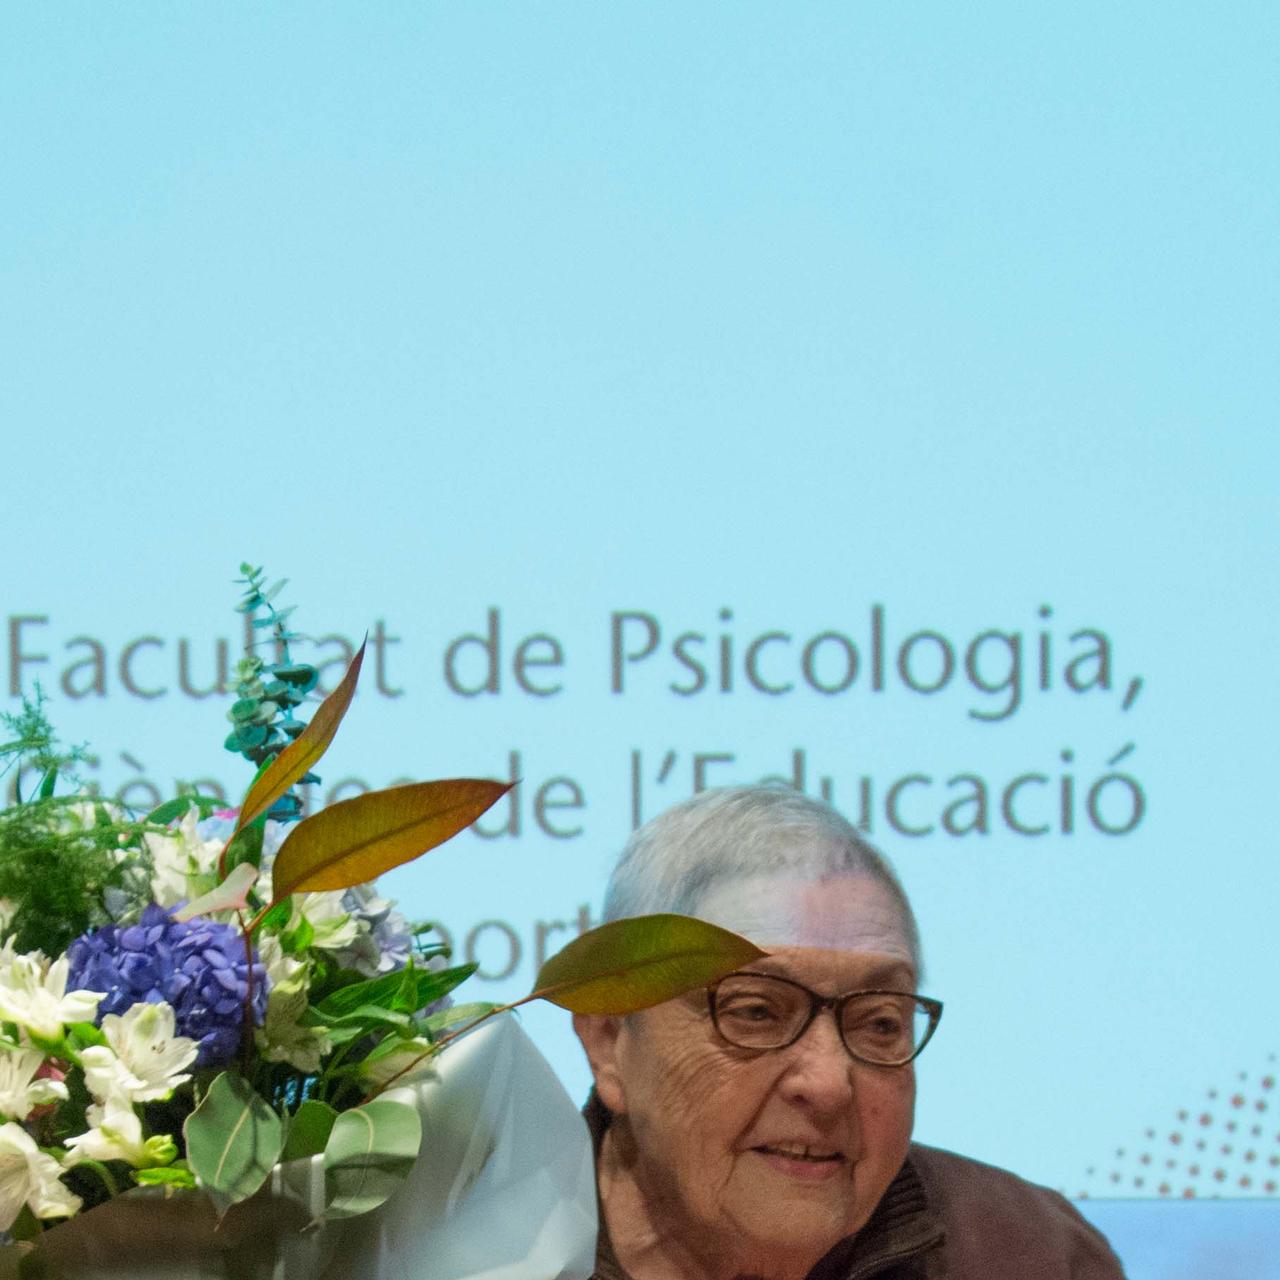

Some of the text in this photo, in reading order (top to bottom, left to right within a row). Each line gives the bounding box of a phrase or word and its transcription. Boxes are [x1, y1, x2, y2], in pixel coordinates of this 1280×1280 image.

[443, 607, 564, 700] de
[610, 604, 1147, 722] Psicologia,
[468, 749, 587, 838] de
